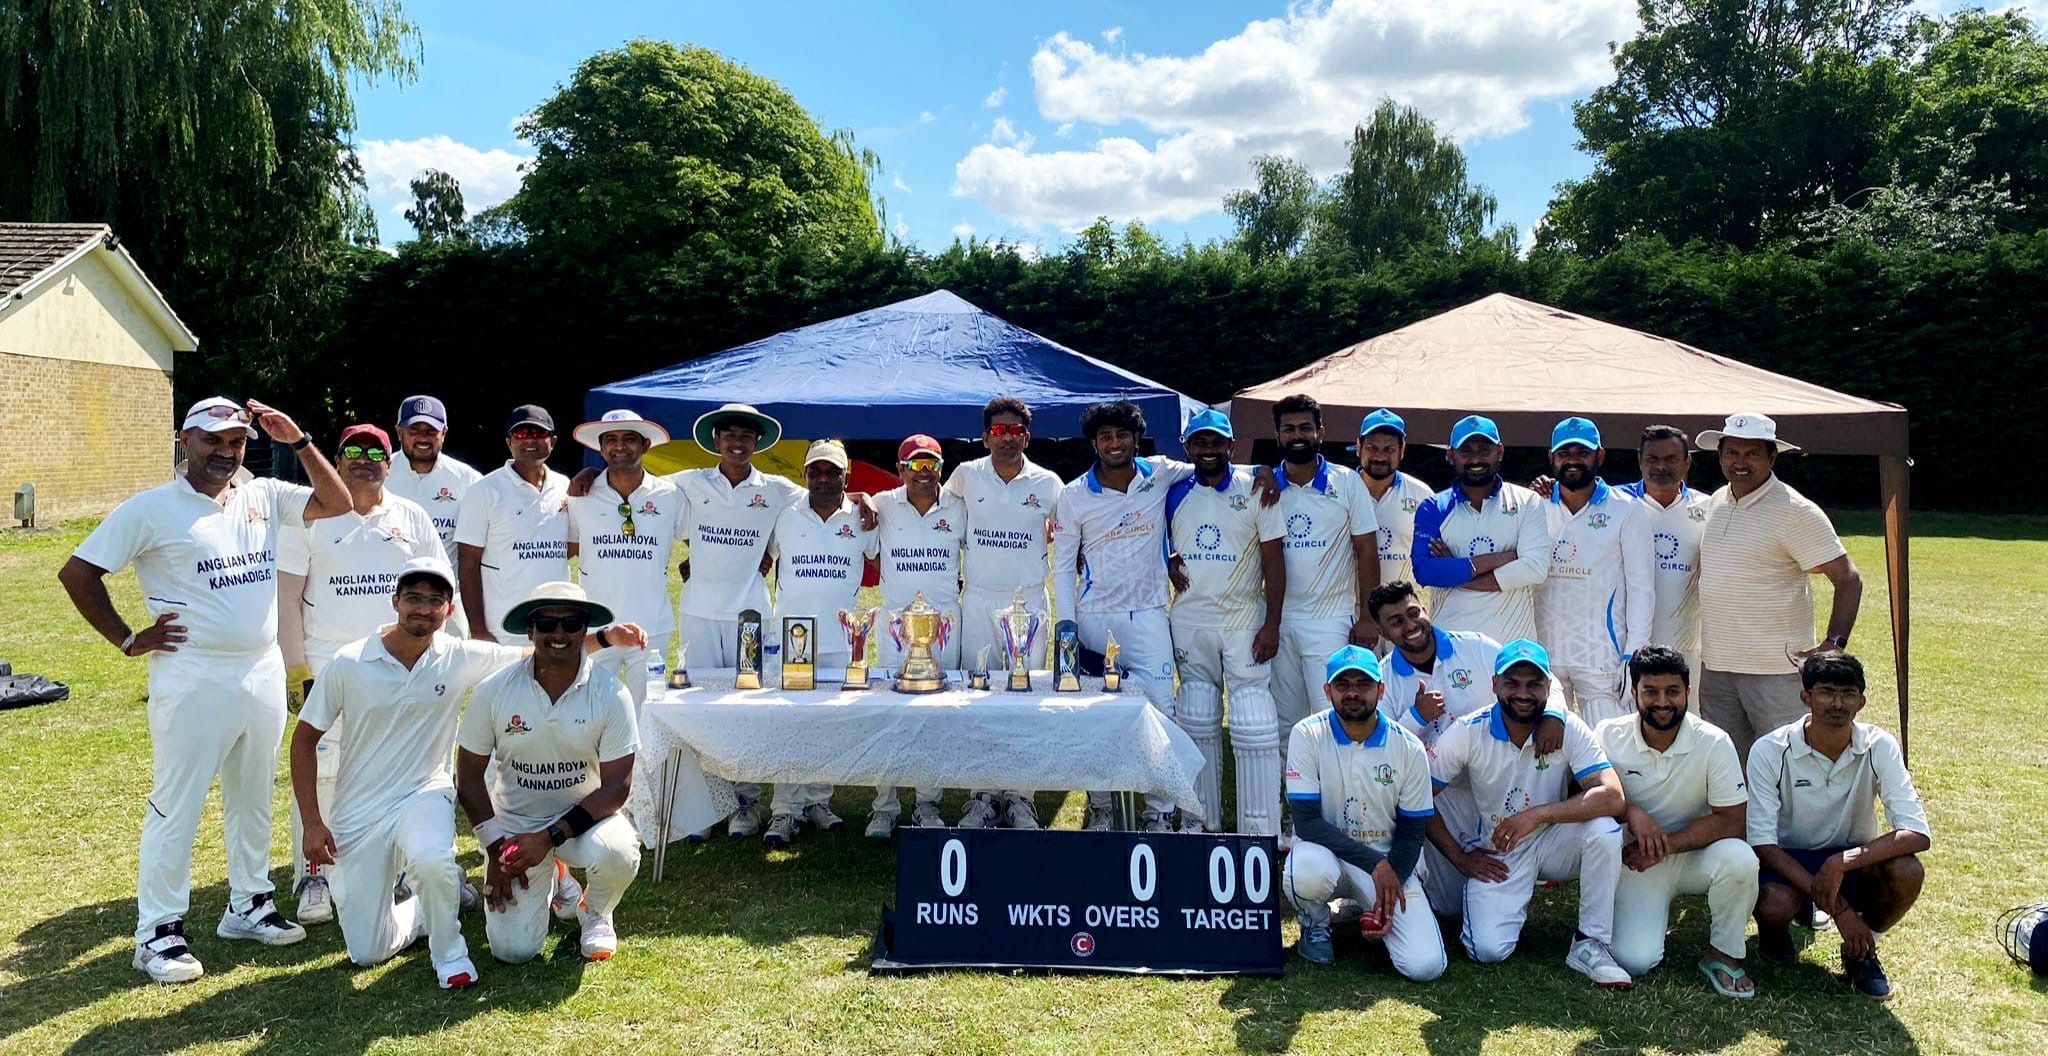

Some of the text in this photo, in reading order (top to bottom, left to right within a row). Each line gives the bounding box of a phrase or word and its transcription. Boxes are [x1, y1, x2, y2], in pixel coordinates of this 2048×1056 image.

[432, 518, 456, 528] OYAL
[698, 523, 760, 538] ANGLIAN ROYAL
[973, 528, 1033, 541] ANGLIAN ROYAL
[512, 541, 551, 551] ANGLIAN
[631, 535, 658, 547] ROYAL
[701, 534, 754, 547] KANNADIGAS
[977, 538, 1028, 549] KANNADIGAS
[1294, 540, 1327, 549] CIRCLE
[597, 548, 653, 560] KANNADIGAS
[891, 548, 951, 558] ANGLIAN ROYAL
[1182, 553, 1237, 562] CARE CIRCLE
[197, 555, 247, 574] ANGLIAN
[792, 554, 851, 566] ANGLIAN ROYAL
[896, 562, 947, 572] KANNADIGAS
[329, 574, 376, 585] ANGLIAN
[795, 568, 847, 579] KANNADIGAS
[511, 759, 555, 775] ANGLIAN
[517, 774, 586, 791] KANNADIGAS
[941, 839, 967, 897] 0
[1130, 843, 1156, 902] 0
[917, 903, 1272, 930] RUNS WKTS OVERS TARGET
